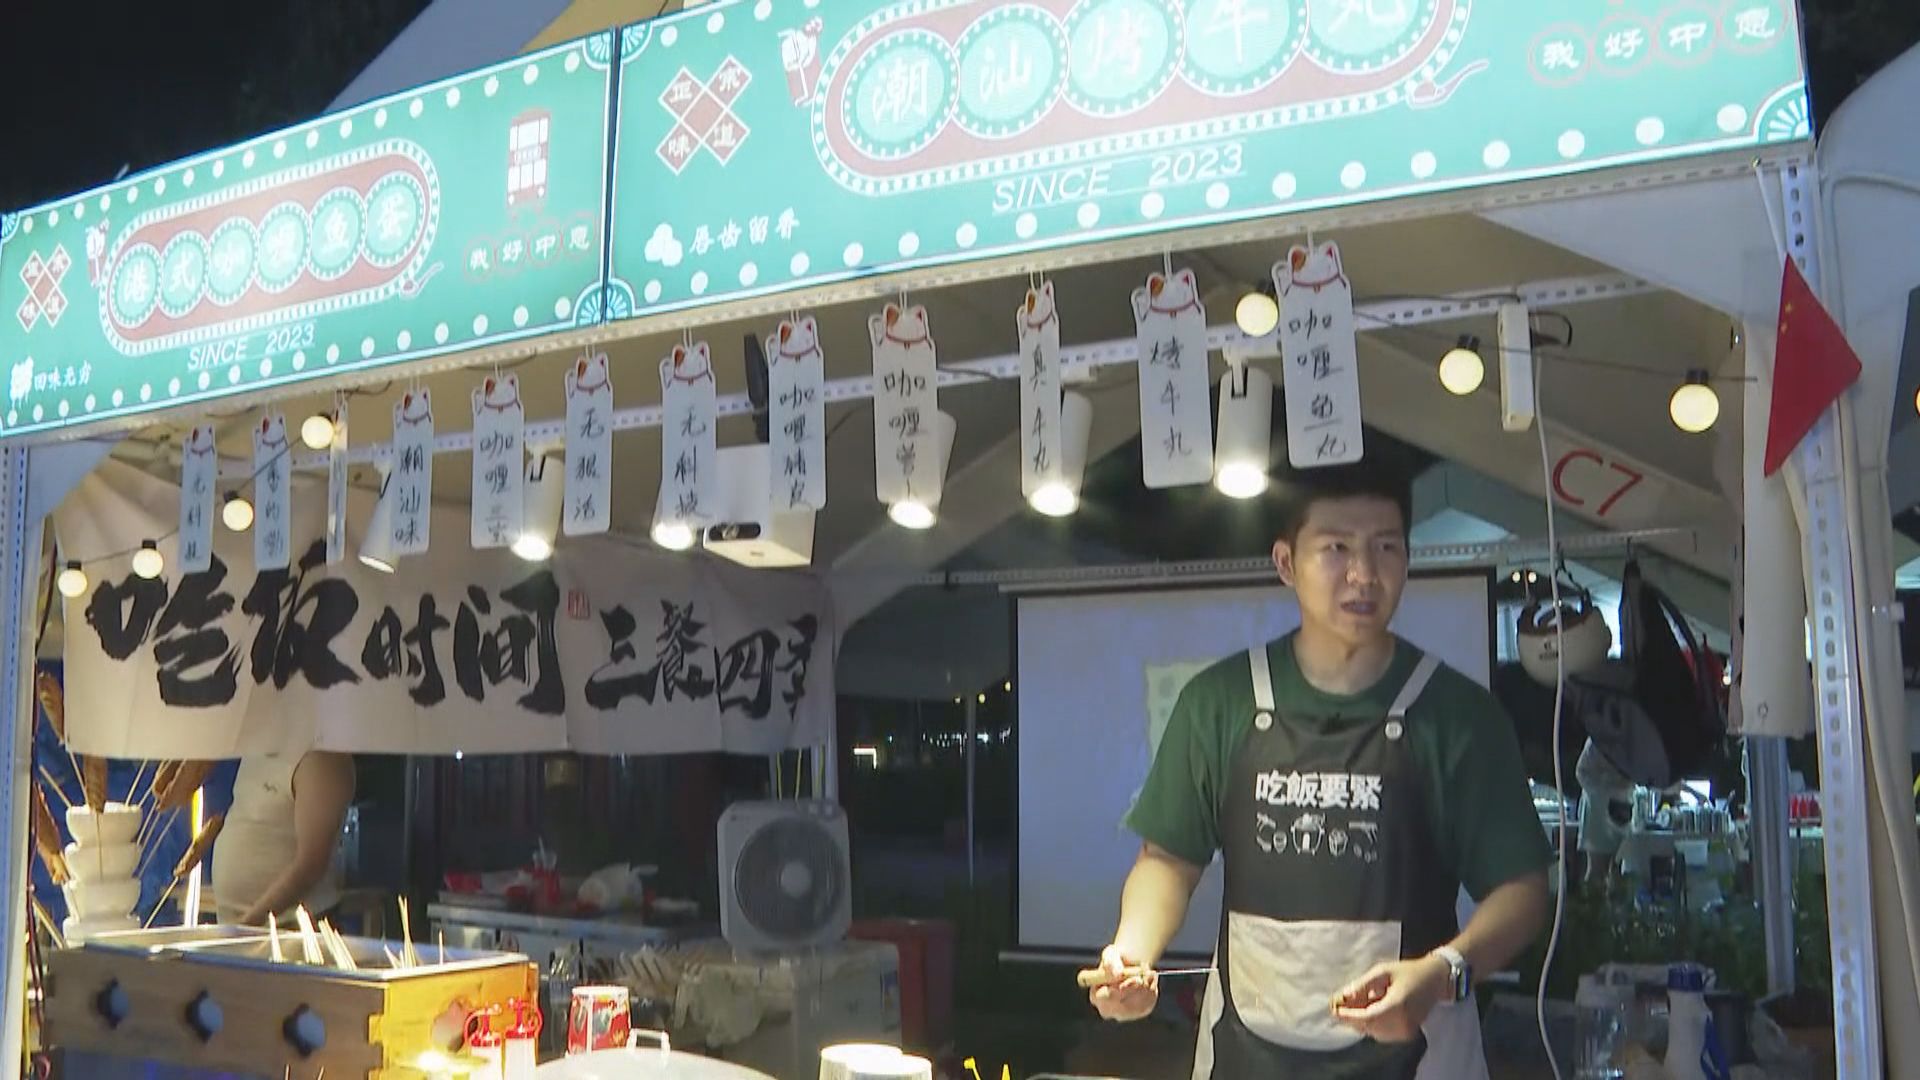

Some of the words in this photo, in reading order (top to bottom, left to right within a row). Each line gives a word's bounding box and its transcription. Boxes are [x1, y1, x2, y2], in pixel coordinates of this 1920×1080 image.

[991, 168, 1112, 214] SINCE
[1150, 144, 1243, 187] 2023
[187, 341, 249, 370] SINCE
[264, 324, 316, 353] 2023
[1552, 447, 1644, 517] C7
[1254, 768, 1384, 812] 吃飯要緊
